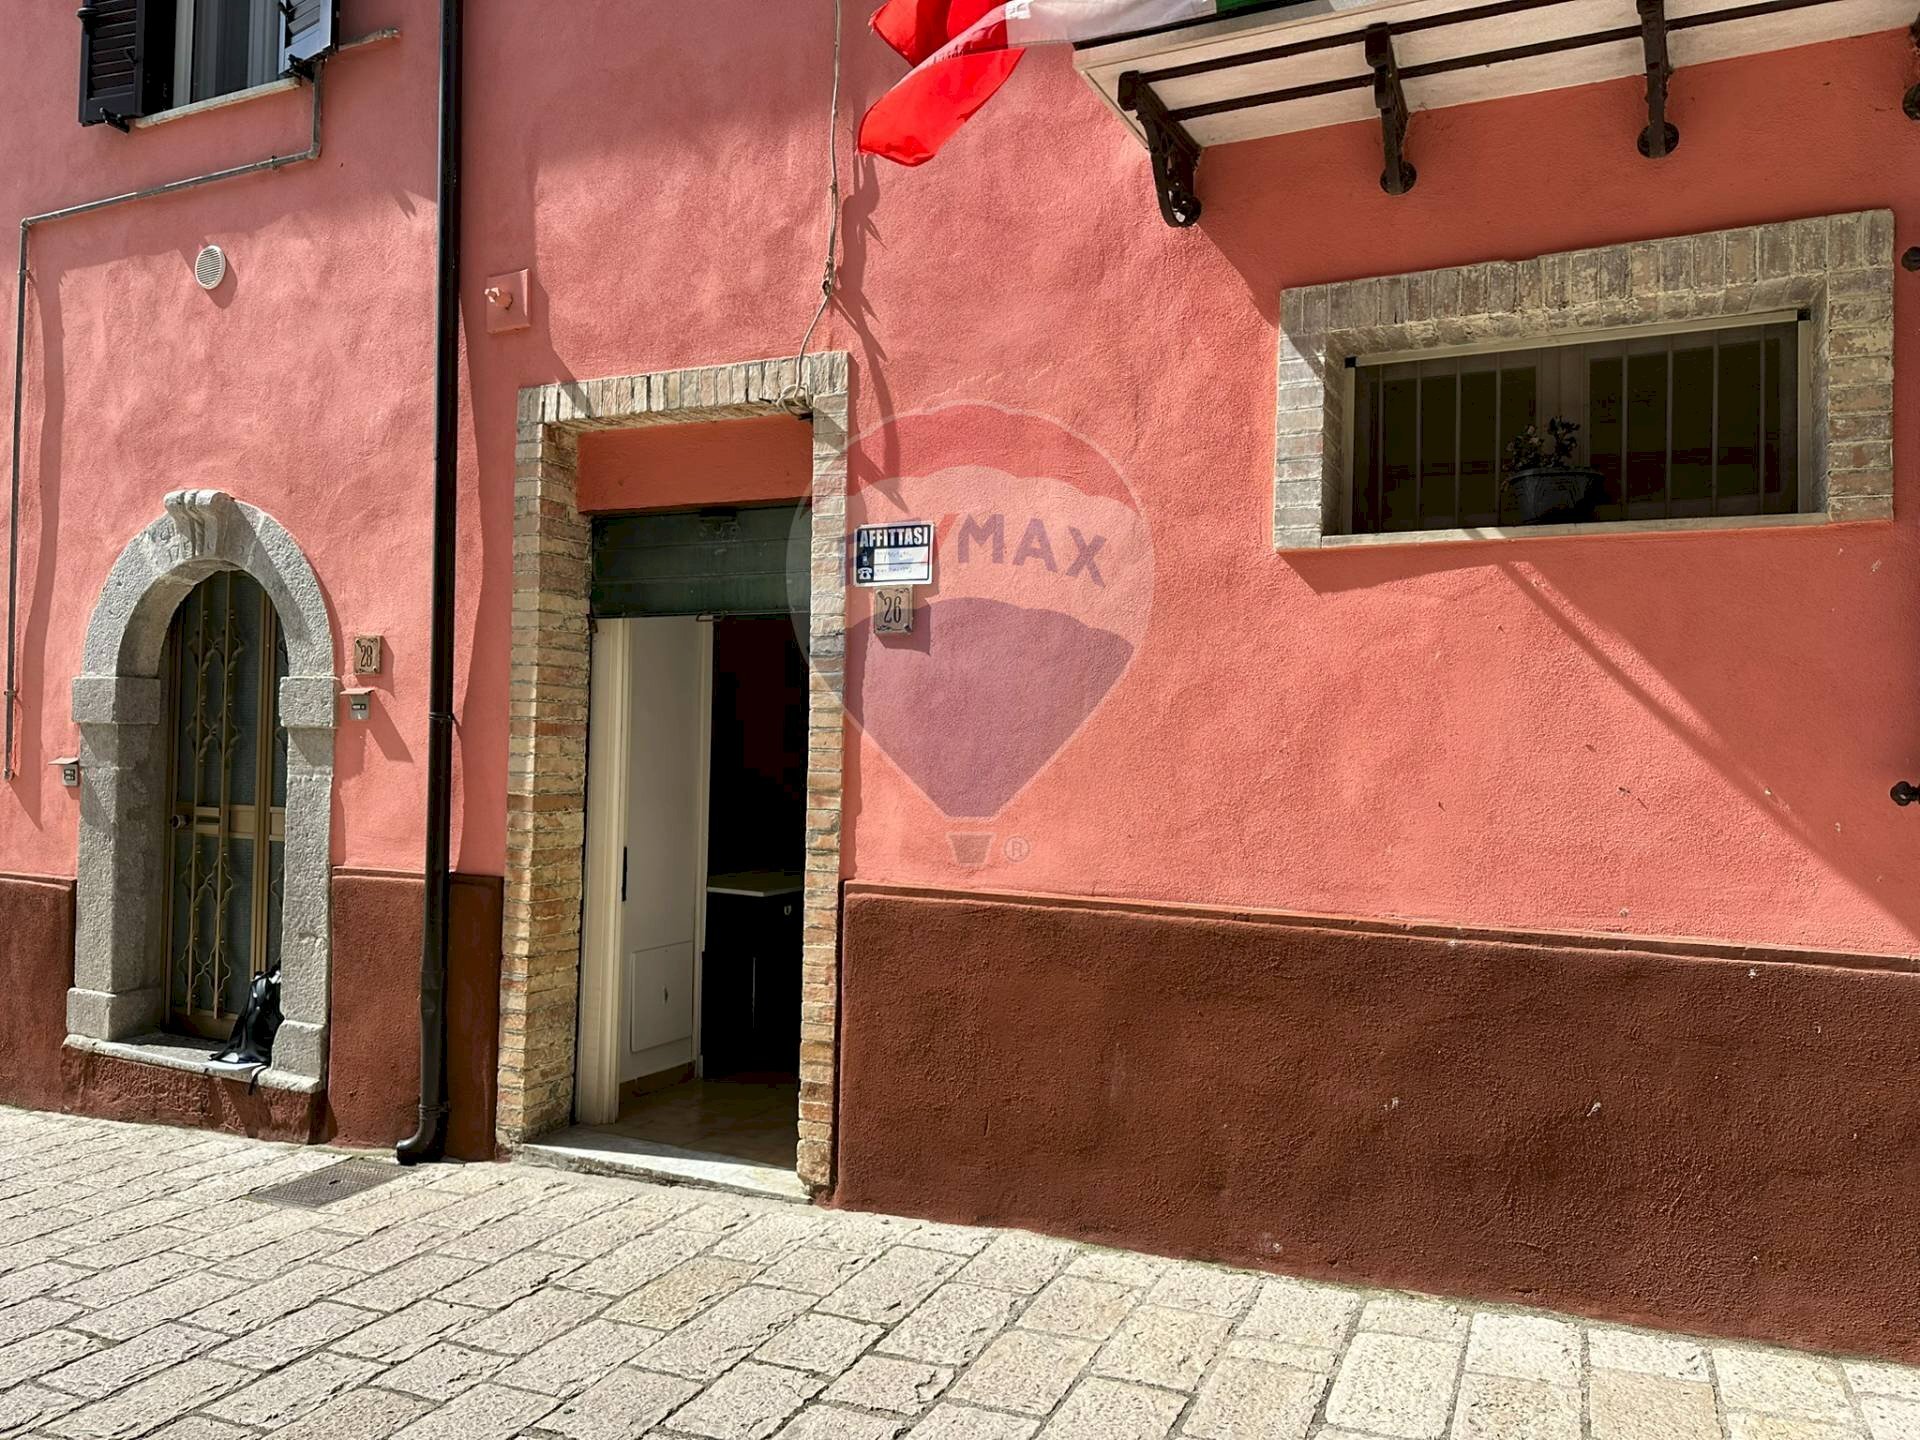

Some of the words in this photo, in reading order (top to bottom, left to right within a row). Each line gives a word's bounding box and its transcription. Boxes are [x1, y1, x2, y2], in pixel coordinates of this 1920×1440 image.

[859, 526, 928, 548] AFFITTASI
[883, 595, 902, 624] 26
[360, 645, 373, 668] 28
